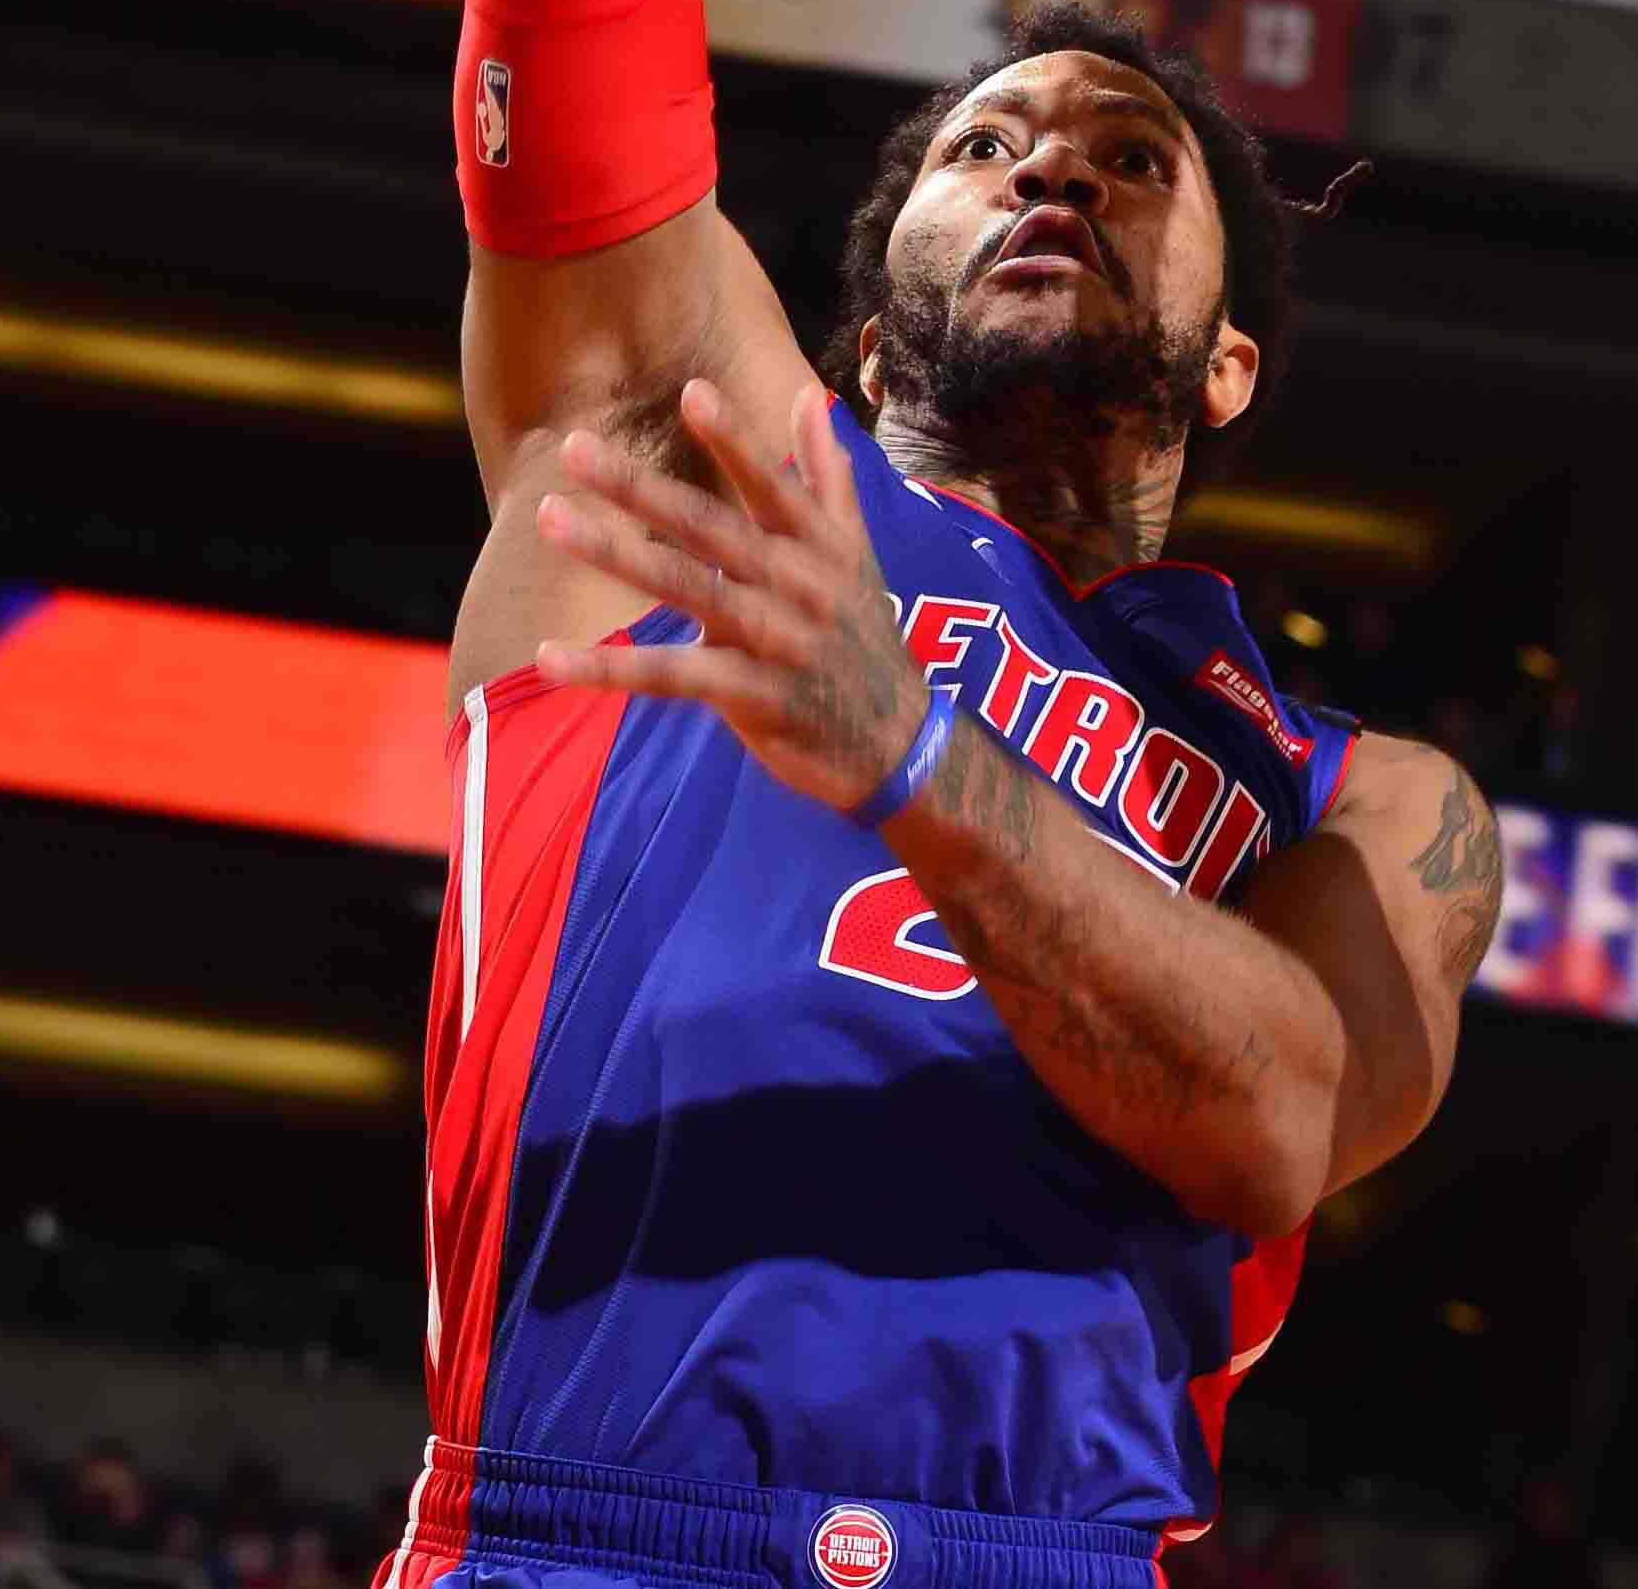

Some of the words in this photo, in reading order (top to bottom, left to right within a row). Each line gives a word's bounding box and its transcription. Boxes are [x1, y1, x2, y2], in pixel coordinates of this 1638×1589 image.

[885, 593, 1269, 902] ETROI
[827, 1533, 881, 1554] DETROIT
[827, 1548, 881, 1568] PISTONS
